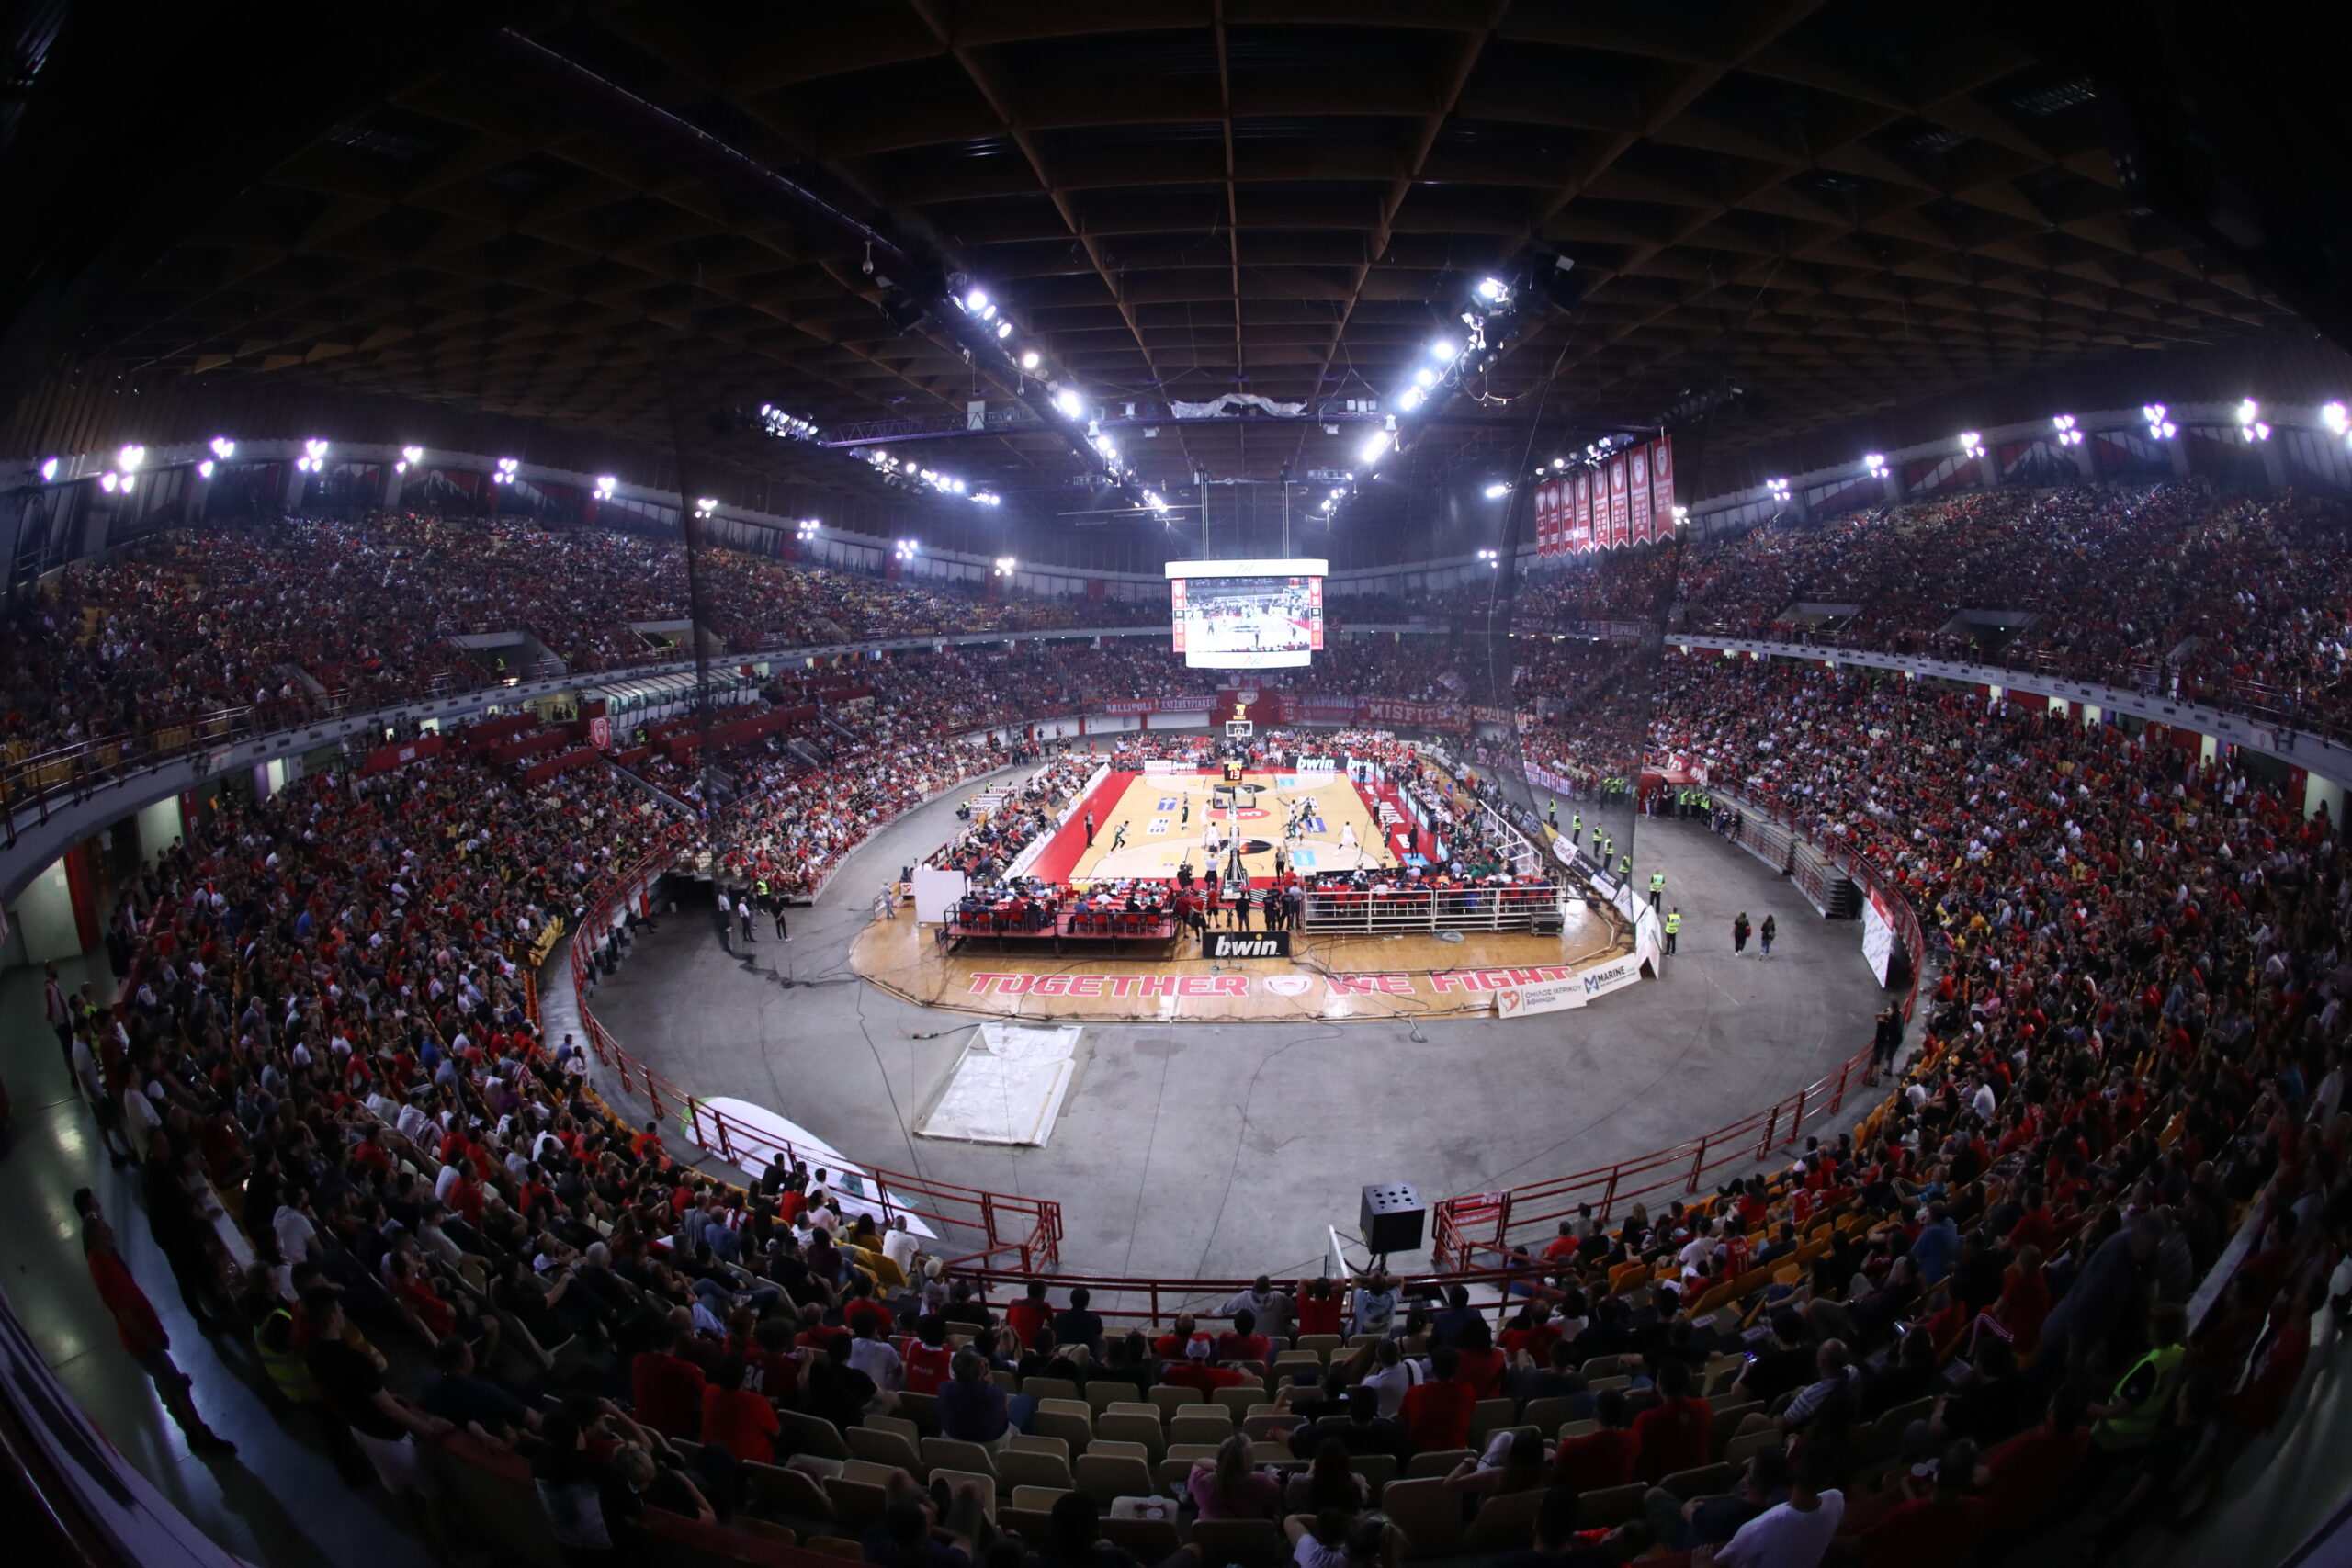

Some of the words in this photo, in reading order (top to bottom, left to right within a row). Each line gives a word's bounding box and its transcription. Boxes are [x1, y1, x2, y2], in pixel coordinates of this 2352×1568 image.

[1369, 704, 1447, 722] MISFITS
[1172, 761, 1198, 770] bwin
[1296, 755, 1335, 770] bwin
[1215, 933, 1278, 956] bwin
[1323, 971, 1416, 998] WE
[1428, 965, 1572, 994] FIGHT
[1598, 965, 1625, 983] MARINE
[968, 972, 1250, 998] TOGETHER
[744, 1365, 765, 1394] 34
